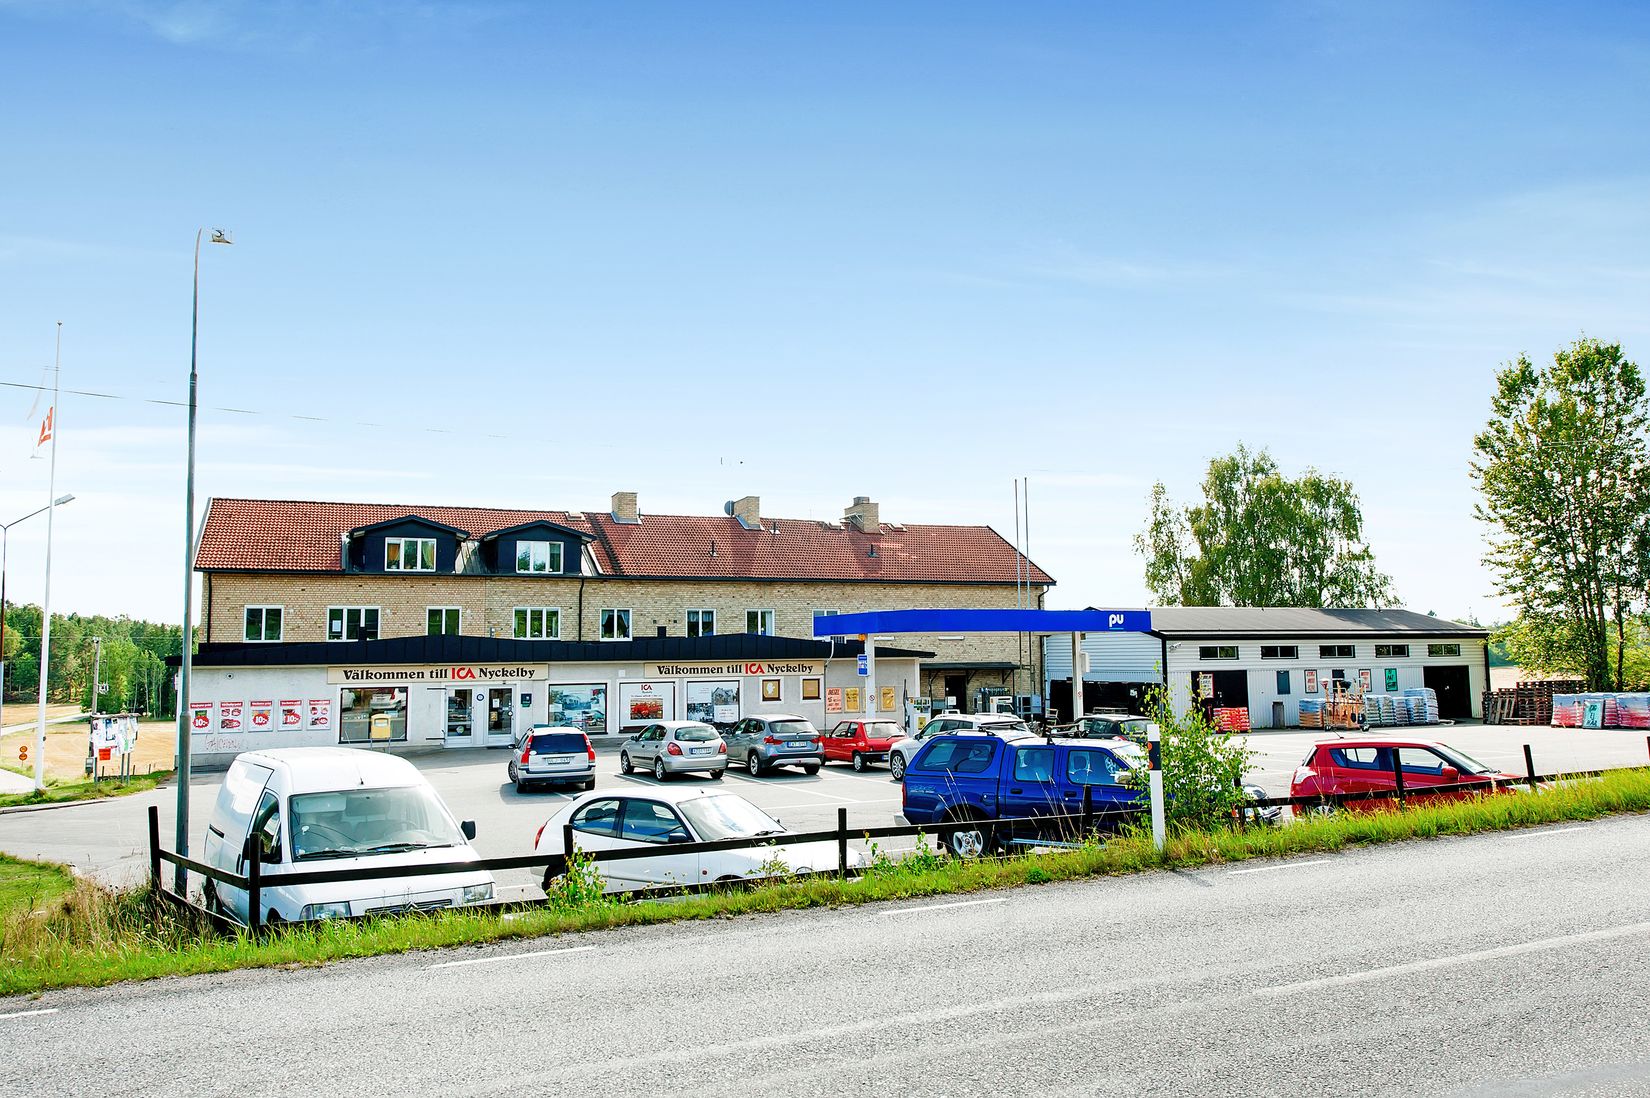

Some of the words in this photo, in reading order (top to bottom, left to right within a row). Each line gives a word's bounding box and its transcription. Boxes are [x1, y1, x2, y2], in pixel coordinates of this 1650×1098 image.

[1109, 614, 1124, 628] pu
[343, 669, 425, 680] Välkommen
[429, 668, 448, 679] till
[451, 667, 476, 679] ICA
[478, 667, 535, 679] Nyckelby
[657, 664, 723, 675] Välkommen
[726, 664, 742, 674] till
[745, 663, 765, 674] ICA
[767, 663, 813, 674] Nyckelby
